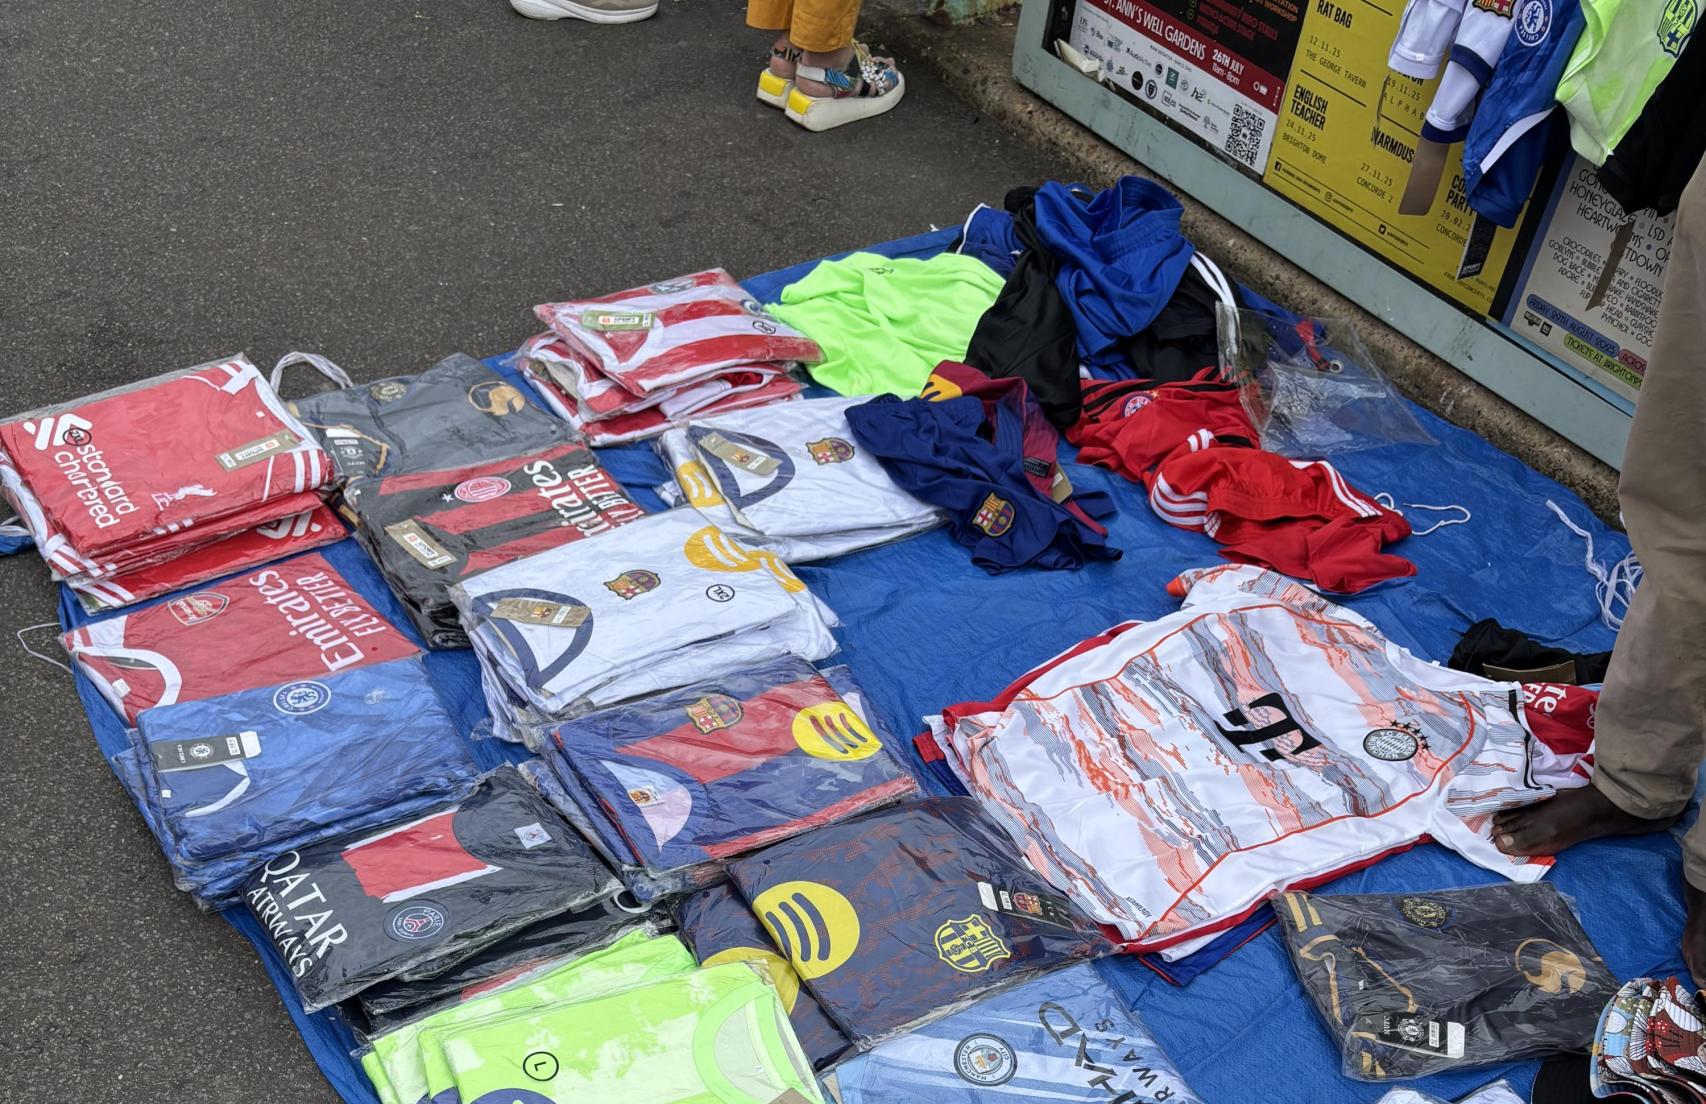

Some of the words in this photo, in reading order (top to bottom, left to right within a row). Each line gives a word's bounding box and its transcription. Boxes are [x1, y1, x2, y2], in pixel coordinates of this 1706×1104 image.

[1317, 0, 1335, 19] RAT
[1333, 8, 1353, 29] BAG
[1143, 10, 1164, 36] WELL
[1164, 25, 1206, 60] GARDENS
[1309, 35, 1342, 58] 12.11.25
[1212, 49, 1230, 68] 26TH
[1229, 60, 1245, 76] JULY
[1306, 49, 1317, 62] THE
[1319, 57, 1342, 75] GEORGE
[1344, 70, 1367, 89] TAVERN
[1293, 84, 1329, 114] ENGLISH
[1290, 99, 1327, 130] TEACHER
[1286, 119, 1317, 142] 24.11.25
[1282, 132, 1310, 155] BRIGHTON
[1311, 149, 1328, 164] DOME
[1360, 162, 1393, 187] 27.11.25
[1356, 176, 1388, 200] CONCORDE
[1387, 194, 1394, 204] 2
[1647, 224, 1666, 241] LSD
[1552, 252, 1568, 267] DOG
[1563, 236, 1602, 265] CROCODILES
[1606, 303, 1624, 320] HEAD
[1569, 319, 1595, 342] AUGUST
[1567, 336, 1594, 358] TICKETS
[1592, 351, 1604, 364] AT
[54, 451, 121, 529] chartered
[76, 444, 140, 517] standard
[711, 584, 731, 600] 2XL
[249, 570, 365, 672] Emirates
[341, 612, 387, 638] FLY
[260, 850, 350, 960] QATAR
[247, 886, 313, 978] AIRWAYS
[961, 1045, 988, 1081] MANCHESTER
[998, 1046, 1010, 1061] CITY
